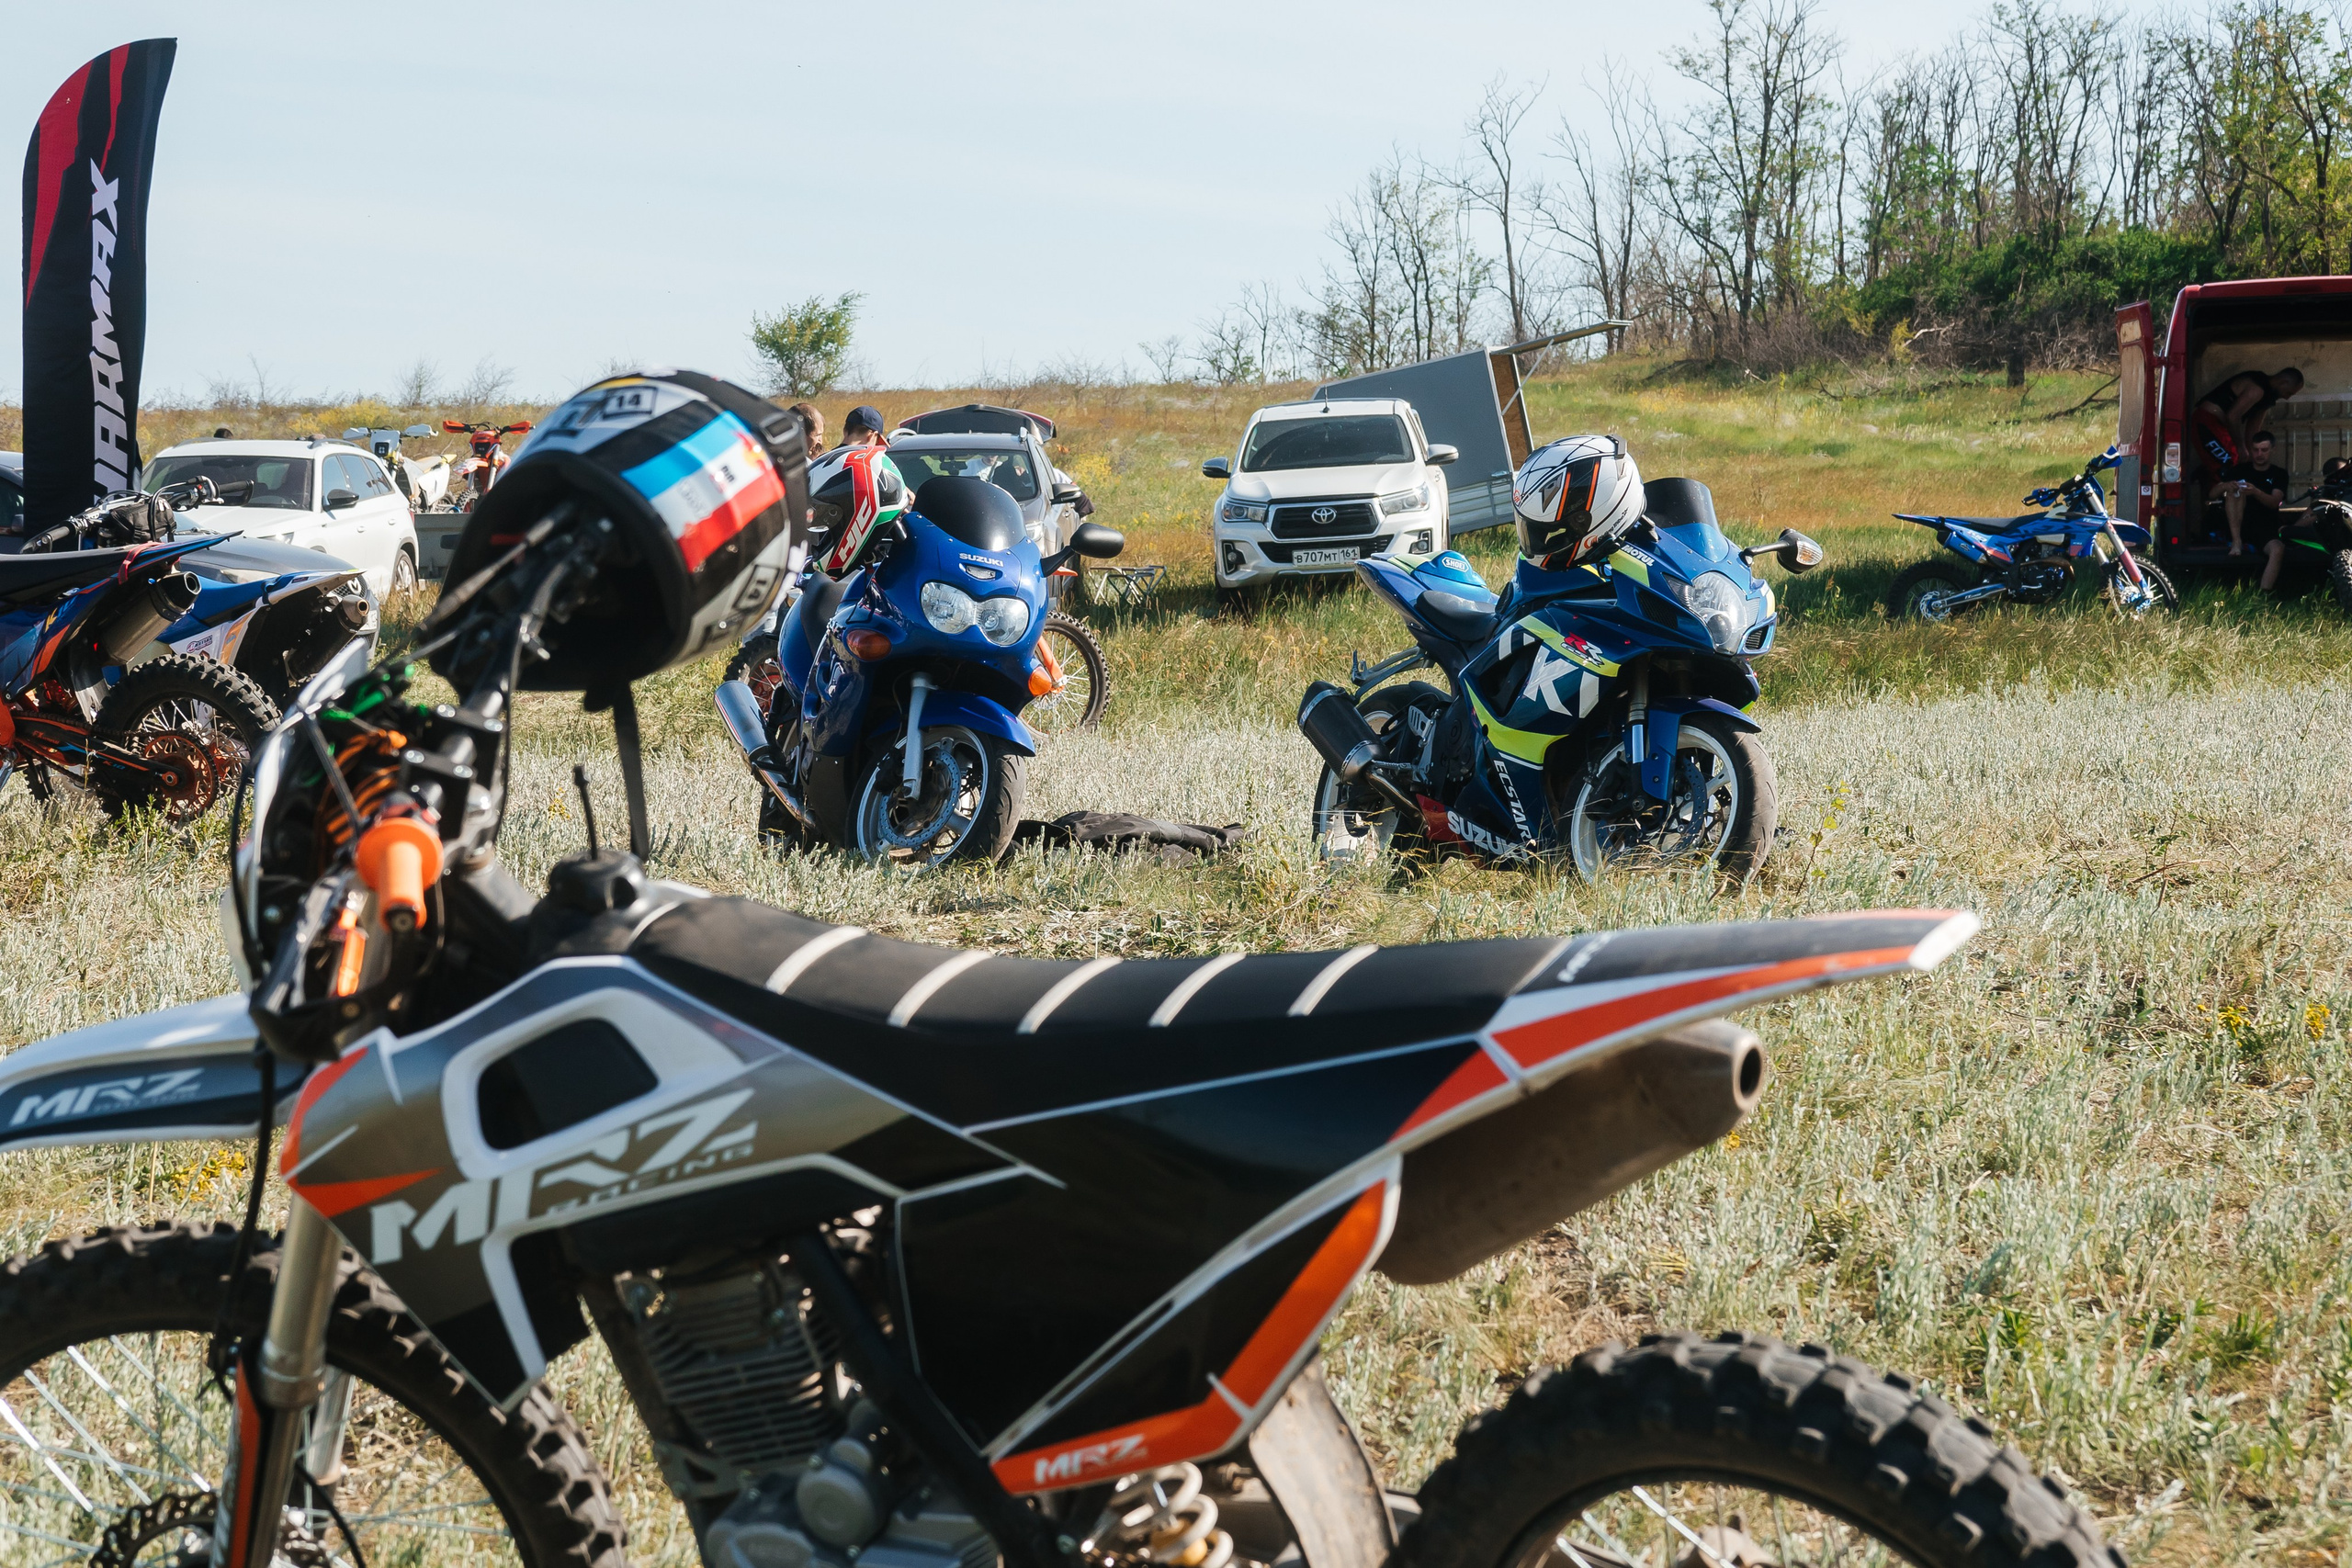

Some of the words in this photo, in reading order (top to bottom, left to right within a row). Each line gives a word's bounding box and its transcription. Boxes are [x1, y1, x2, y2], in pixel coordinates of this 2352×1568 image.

[89, 157, 128, 501] HARMAX
[616, 393, 641, 408] 14
[2206, 440, 2231, 463] FOX
[838, 496, 872, 563] HJC
[958, 552, 1004, 568] SUZUKI
[1340, 549, 1357, 558] 161
[1445, 558, 1465, 570] SHOEI
[1622, 545, 1655, 566] MOTUL
[1493, 760, 1532, 843] ECSTAR
[10, 1067, 204, 1126] MRZ
[370, 1089, 759, 1266] MRZ
[1035, 1434, 1148, 1484] MRZ
